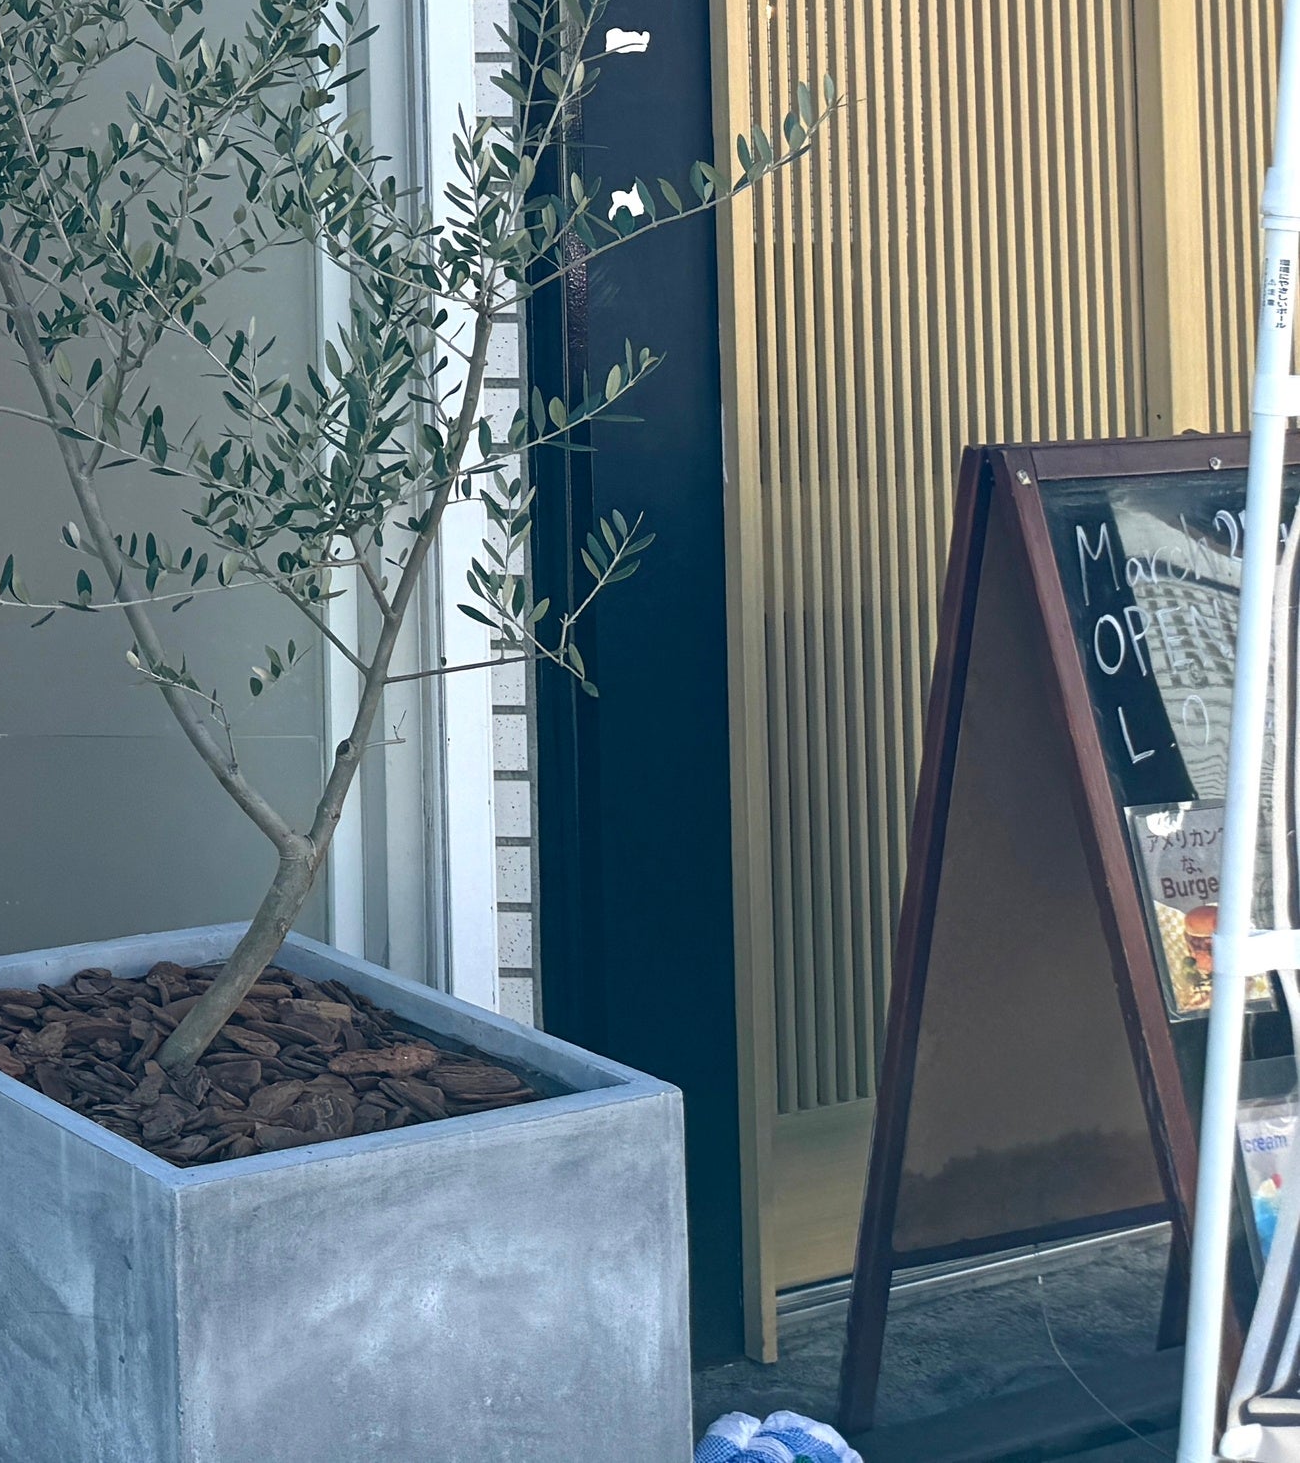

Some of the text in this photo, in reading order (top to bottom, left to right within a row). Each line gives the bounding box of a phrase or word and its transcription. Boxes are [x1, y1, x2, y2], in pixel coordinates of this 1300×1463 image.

[1076, 513, 1218, 606] March
[1094, 599, 1235, 676] OPEN
[1146, 827, 1224, 853] アメリカン
[1161, 876, 1220, 900] Burge
[1242, 1134, 1289, 1154] cream
